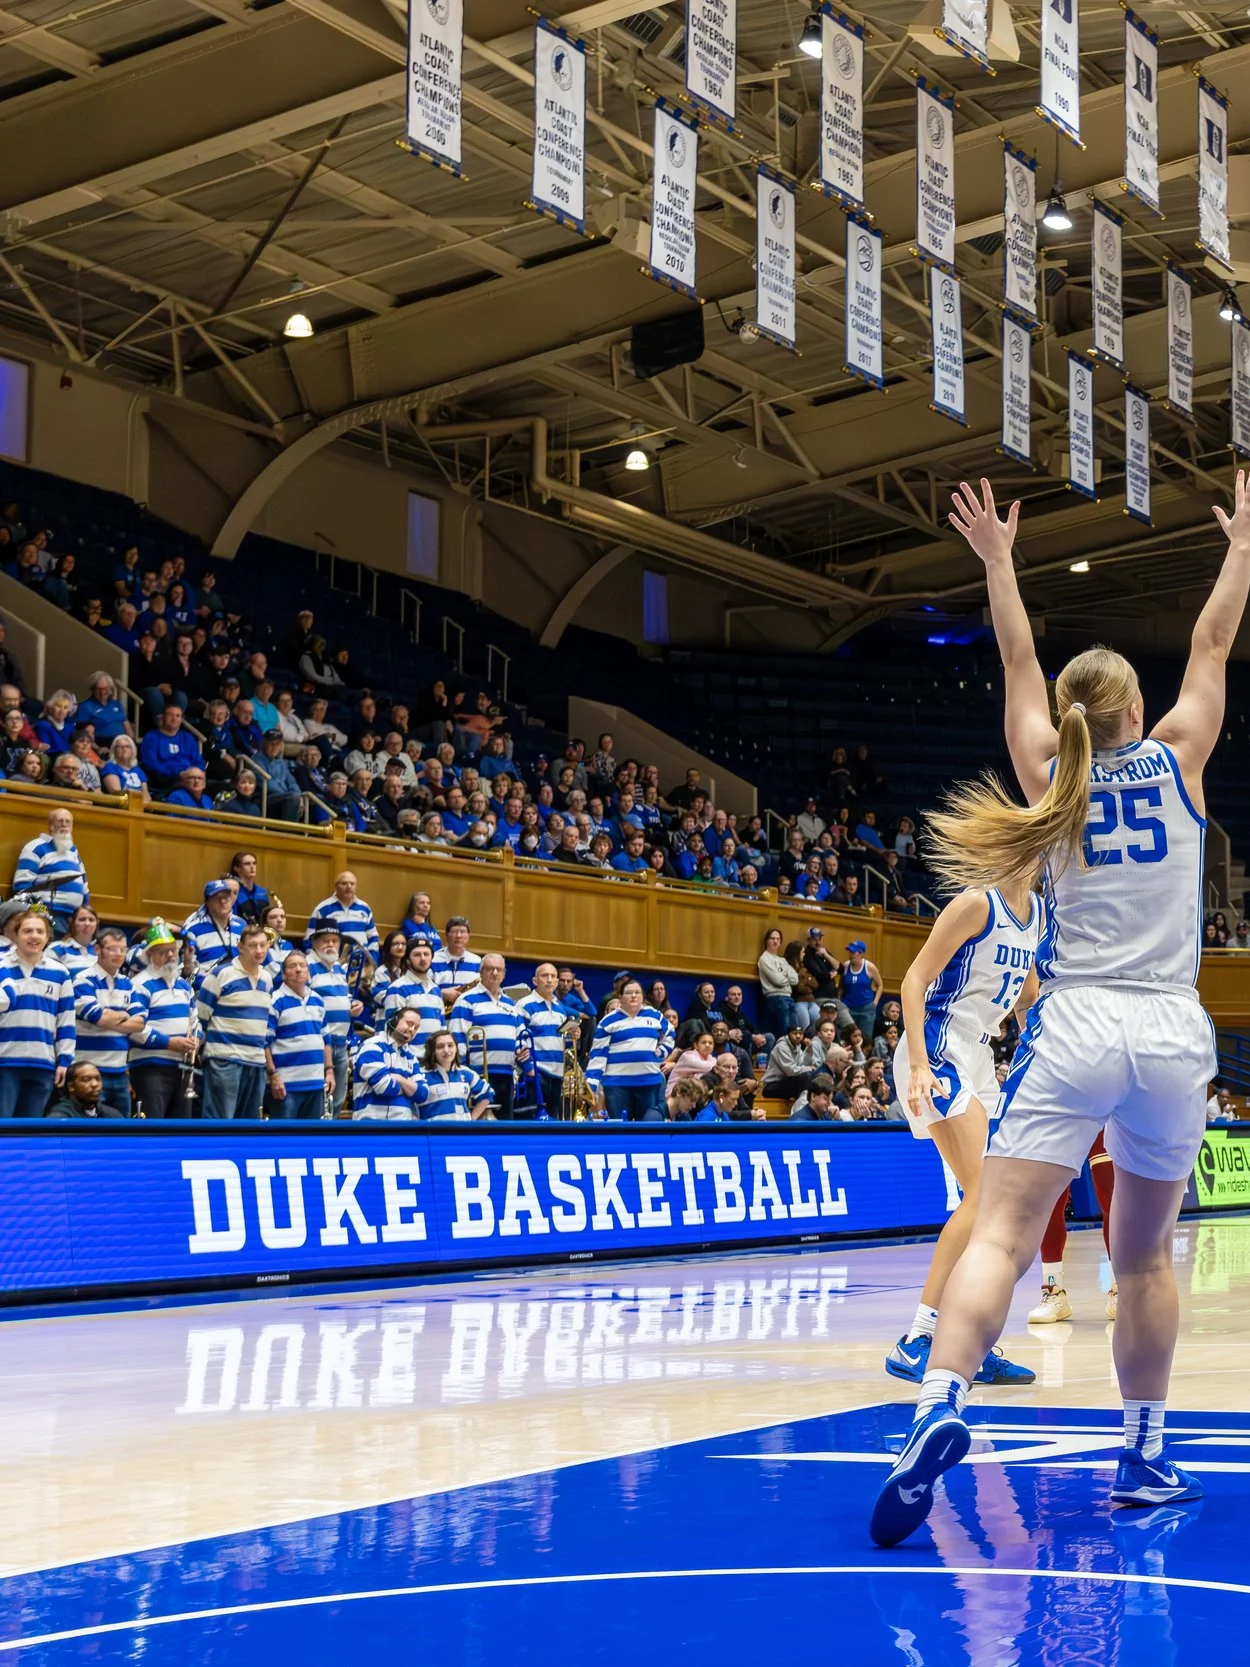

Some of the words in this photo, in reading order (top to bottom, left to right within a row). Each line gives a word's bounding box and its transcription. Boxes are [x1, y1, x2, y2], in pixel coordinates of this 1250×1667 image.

[702, 6, 724, 30] COAST
[420, 32, 454, 63] ATLANTIC
[691, 15, 734, 55] CONFERENCE
[1054, 32, 1069, 55] NCAA
[424, 52, 449, 76] COAST
[693, 33, 732, 71] CHAMPIONS
[1045, 48, 1061, 70] FINAL
[412, 61, 461, 100] CONFERENCE
[704, 78, 722, 99] 1964
[414, 80, 459, 116] CHAMPIONS
[830, 84, 856, 110] ATLANTIC
[834, 101, 853, 121] COAST
[425, 124, 446, 146] 2006
[551, 117, 572, 139] COAST
[824, 111, 863, 144] CONFERENCE
[537, 126, 582, 161] CONFERENCE
[826, 127, 861, 158] CHAMPIONS
[538, 144, 580, 176] CHAMPIONS
[551, 183, 569, 204] 2009
[661, 174, 689, 200] ATANTIC
[920, 180, 955, 210] CONFERENCE
[655, 201, 694, 230] CONFRENCE
[921, 195, 952, 224] CHAMPIONS
[765, 237, 790, 260] ATLANTIC
[665, 254, 685, 272] 2010
[760, 263, 795, 289] CONFERENCE
[762, 277, 794, 303] CHAMPIONS
[771, 312, 786, 329] 2011
[850, 305, 880, 328] CONFERENCE
[851, 318, 880, 342] CHAMPIONS
[1082, 786, 1168, 867] 25
[181, 1156, 426, 1254] DUKE
[444, 1149, 848, 1239] BASKETBALL
